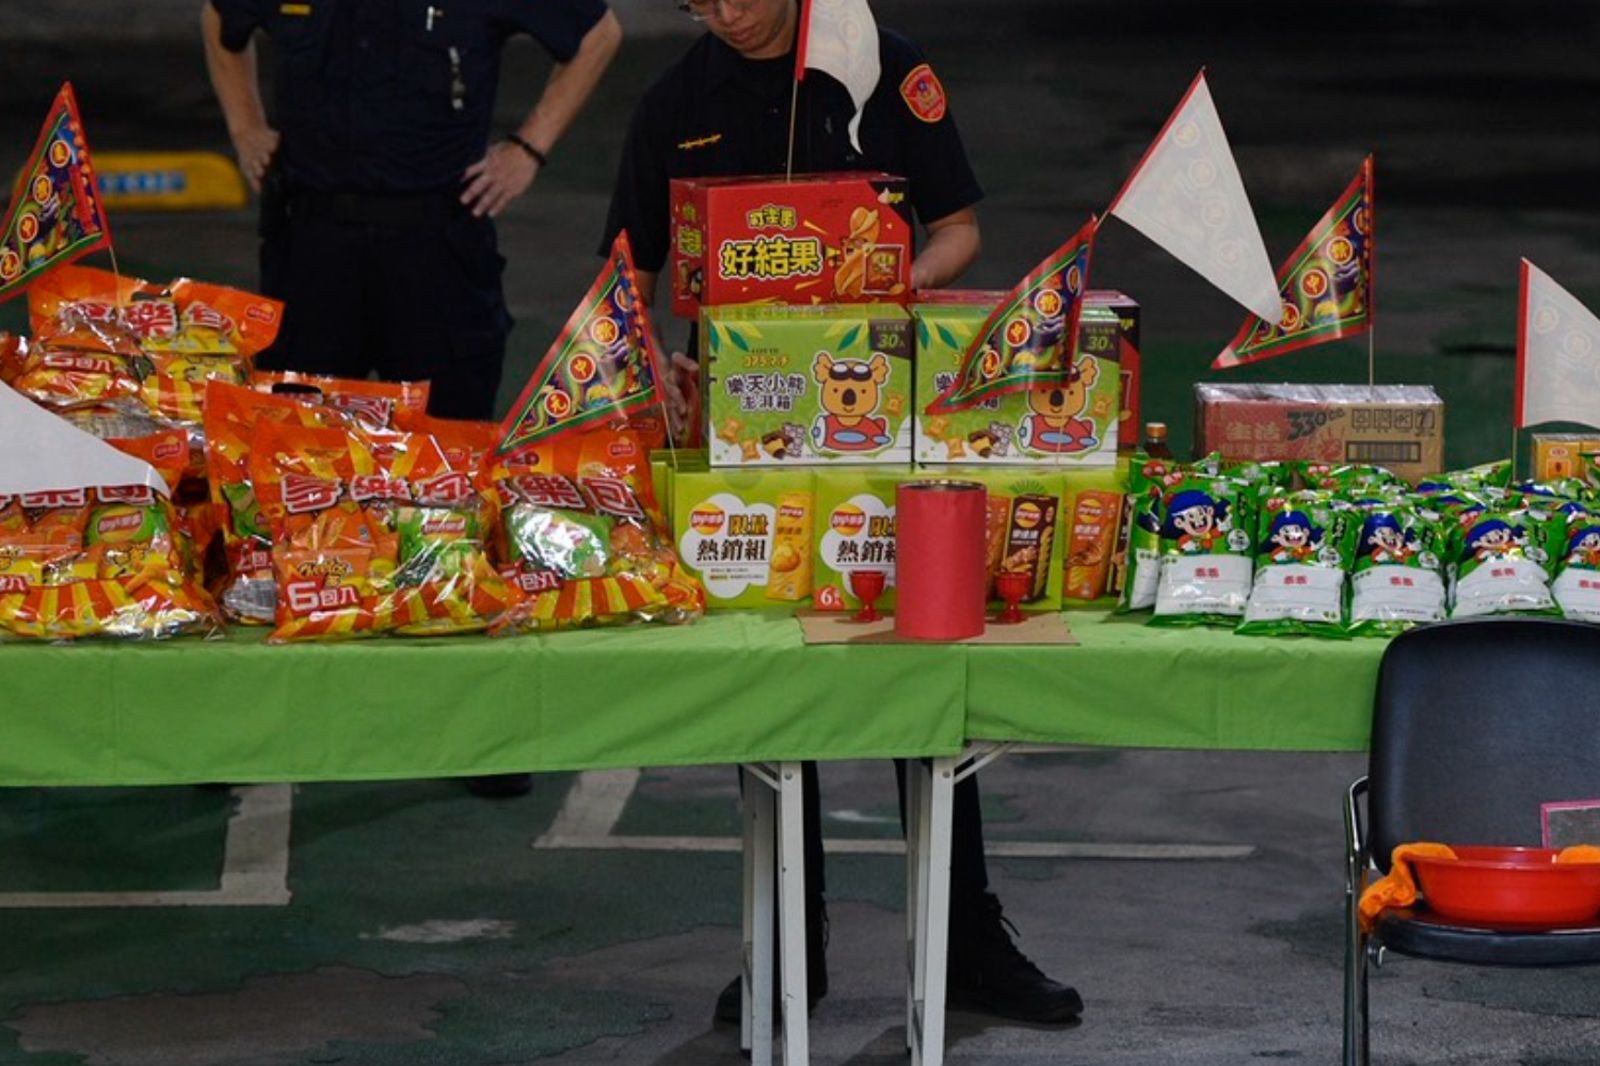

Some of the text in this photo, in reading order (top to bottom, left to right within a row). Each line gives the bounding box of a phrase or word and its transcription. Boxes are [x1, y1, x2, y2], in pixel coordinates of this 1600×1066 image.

[721, 238, 821, 277] 好結果
[728, 375, 806, 395] 樂天小熊
[696, 539, 766, 562] 熱銷組
